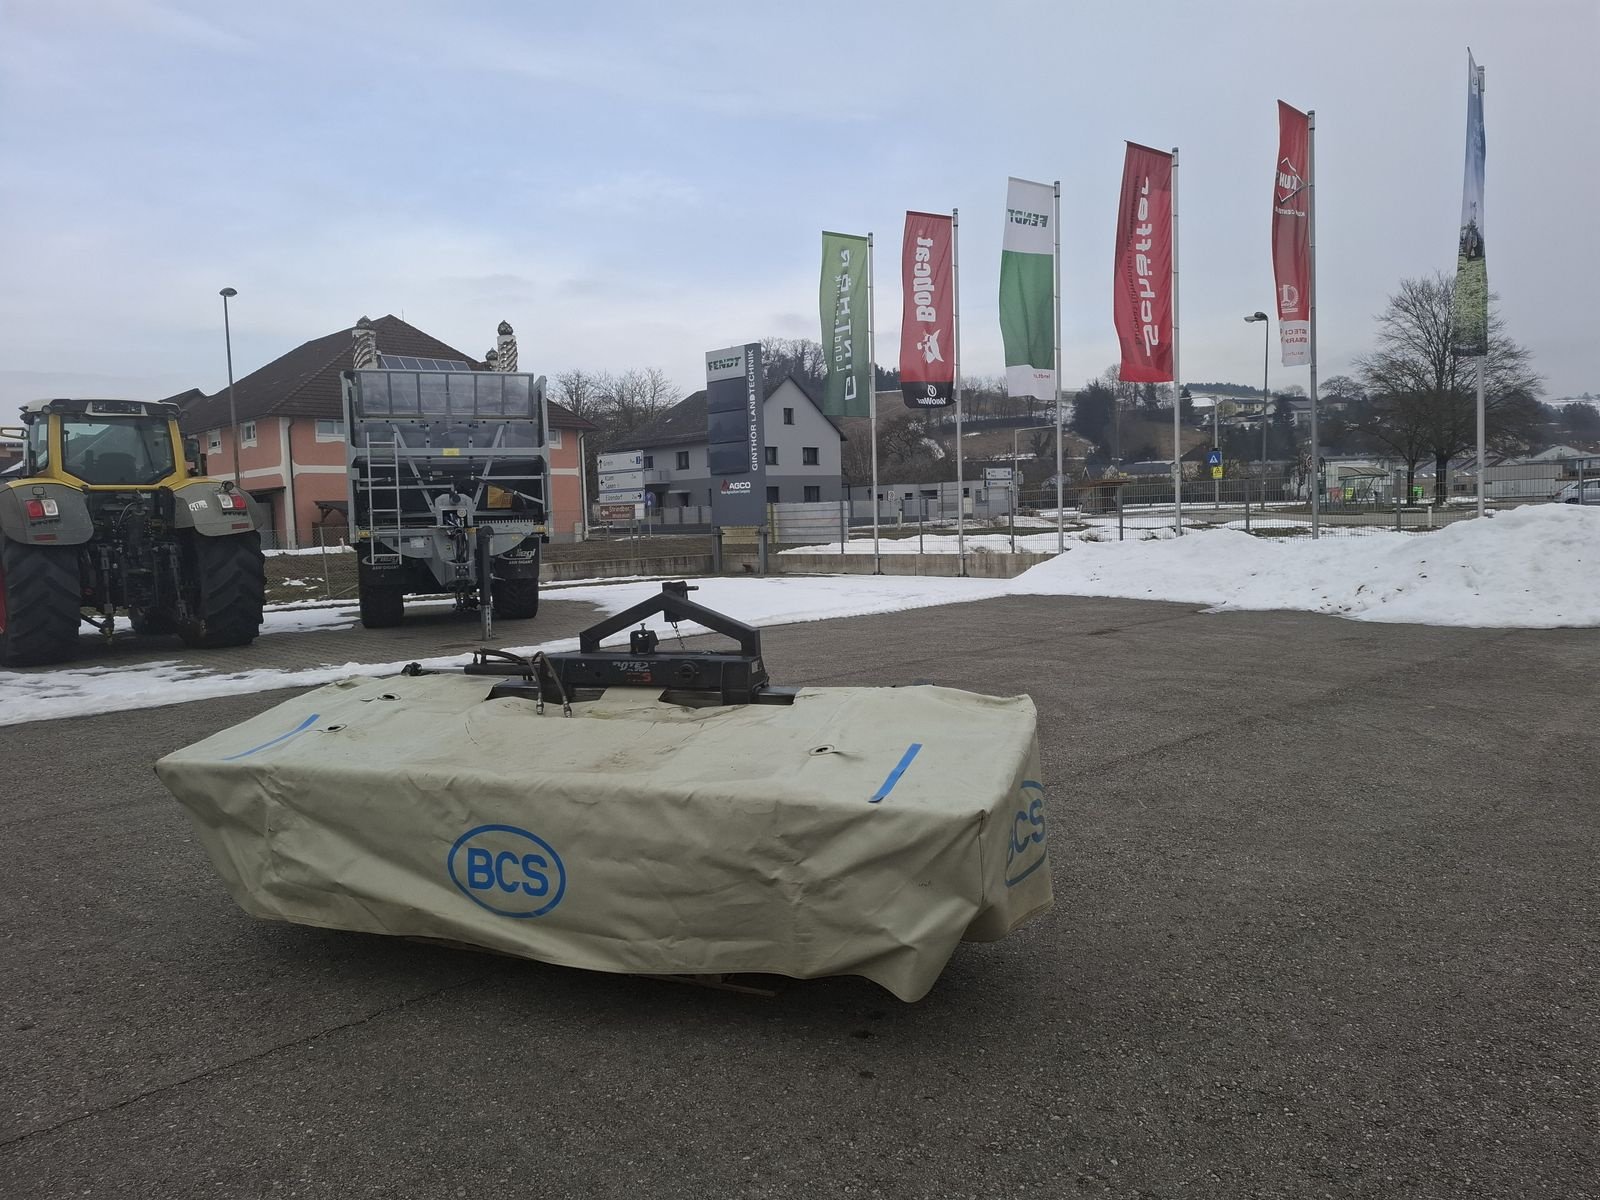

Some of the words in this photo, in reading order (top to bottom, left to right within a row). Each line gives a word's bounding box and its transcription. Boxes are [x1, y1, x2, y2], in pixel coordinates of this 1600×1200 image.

[707, 356, 741, 371] FENDT
[747, 349, 757, 422] LANDTECHNIK
[729, 482, 751, 490] AGCO
[467, 847, 549, 897] BCS
